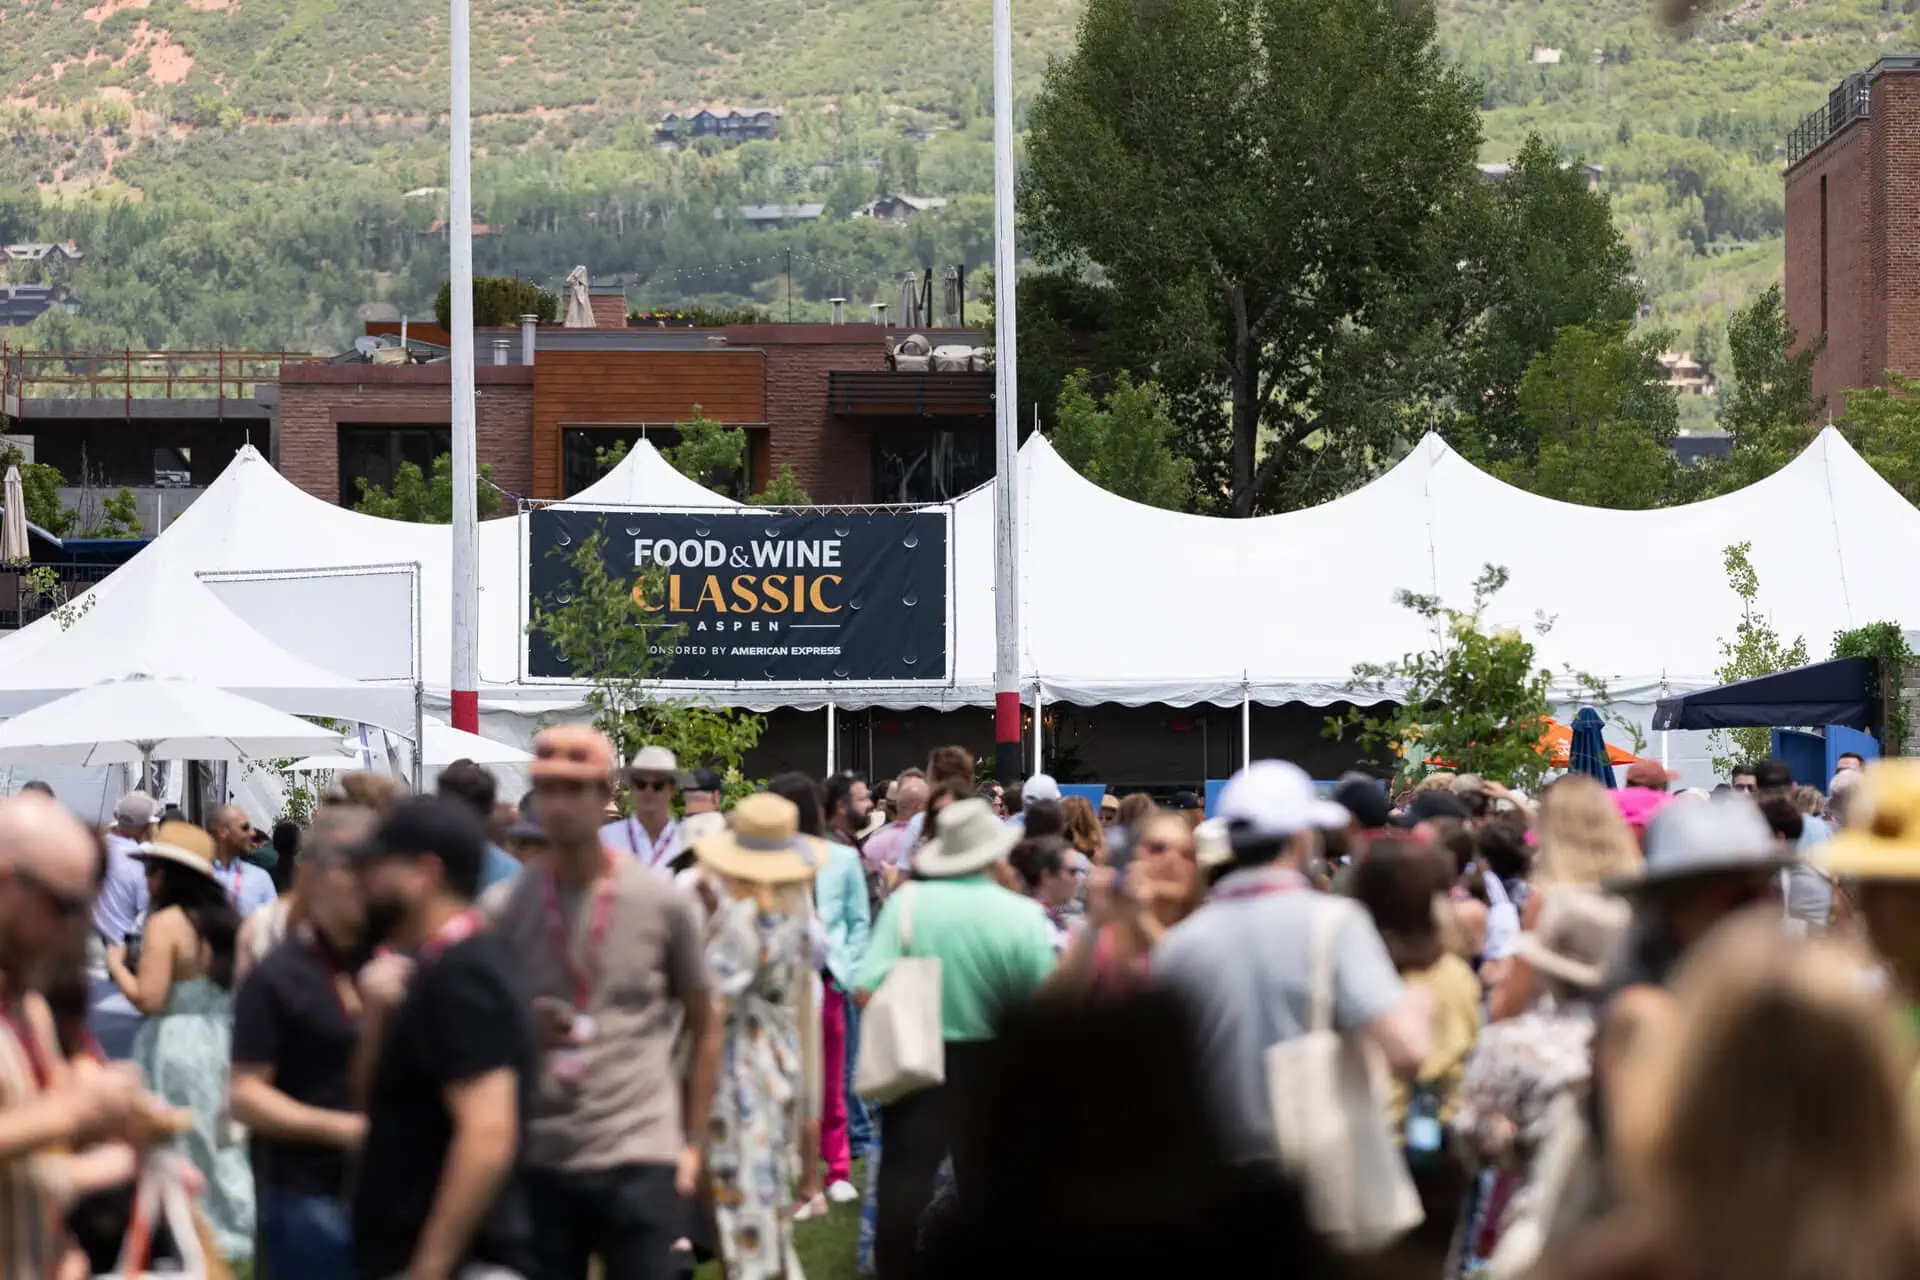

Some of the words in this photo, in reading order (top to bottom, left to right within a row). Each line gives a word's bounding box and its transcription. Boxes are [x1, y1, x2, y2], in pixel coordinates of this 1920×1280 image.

[634, 538, 842, 568] FOOD&WINE
[632, 574, 842, 613] CLASSIC
[696, 620, 779, 632] ASPEN
[649, 645, 706, 655] ONSORED
[711, 646, 727, 655] BY
[730, 646, 788, 656] AMERICAN
[791, 646, 841, 655] EXPRESS
